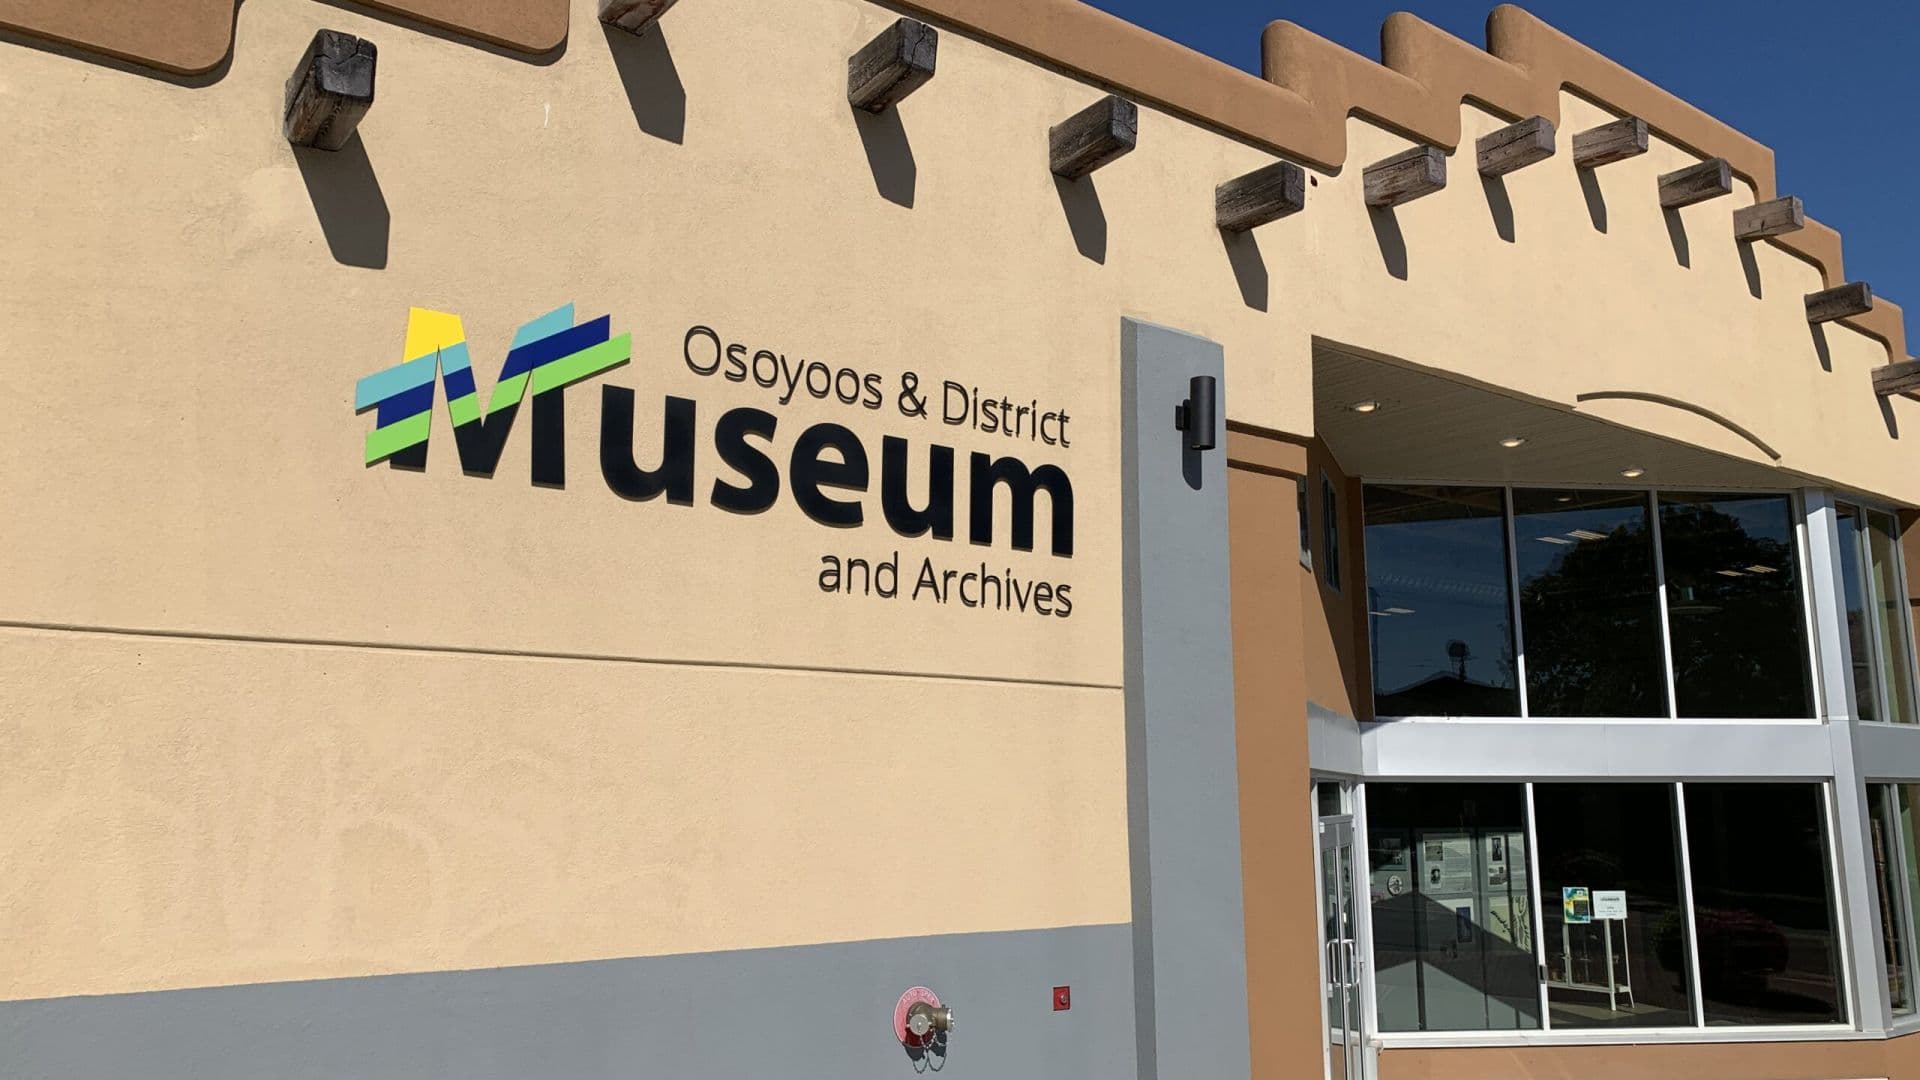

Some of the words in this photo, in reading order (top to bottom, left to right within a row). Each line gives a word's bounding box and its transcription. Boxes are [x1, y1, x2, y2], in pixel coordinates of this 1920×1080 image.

[355, 302, 1074, 559] Museum
[683, 325, 883, 406] Osoyoos
[897, 371, 928, 420] &
[942, 380, 1071, 449] District
[818, 550, 899, 599] and
[911, 556, 1073, 618] Archives
